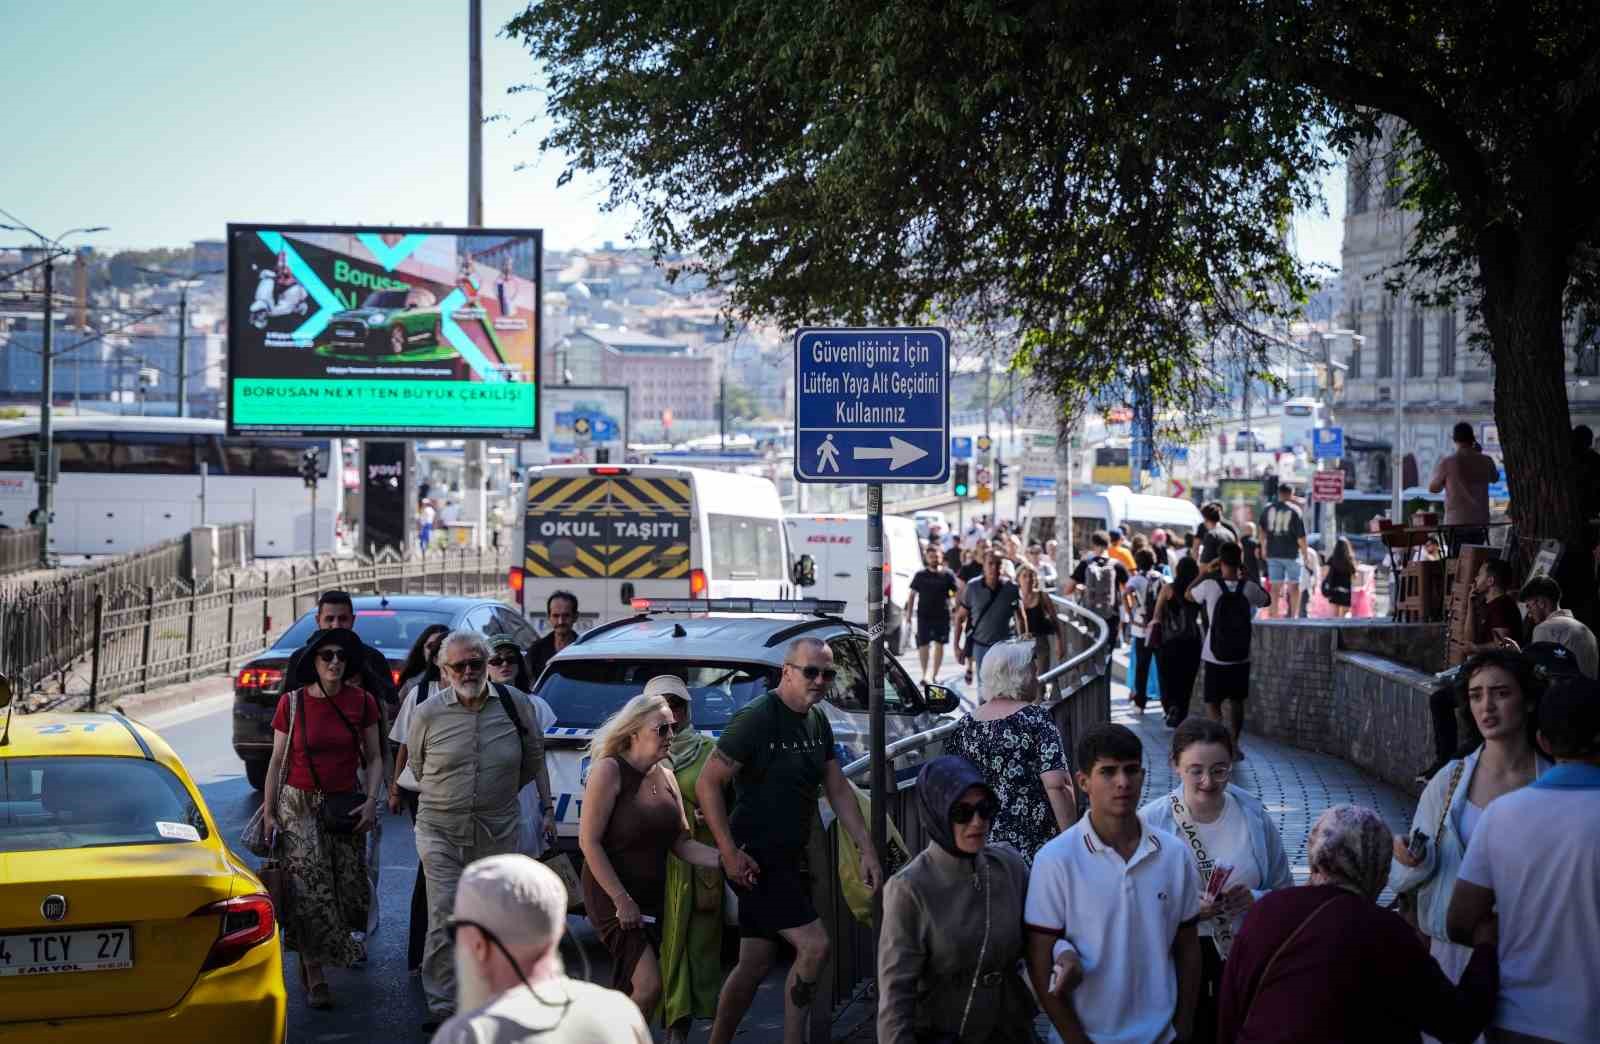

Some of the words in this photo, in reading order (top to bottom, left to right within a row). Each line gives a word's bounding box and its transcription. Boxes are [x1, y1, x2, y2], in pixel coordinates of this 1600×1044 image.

[812, 340, 900, 368] Güvenliğiniz
[904, 335, 930, 368] İçin
[242, 386, 319, 398] BORUSAN
[803, 372, 839, 394] Lütfen
[842, 372, 869, 400] Yaya
[872, 371, 889, 394] Alt
[891, 371, 940, 400] Geçidini
[836, 402, 906, 424] Kullanınız
[540, 522, 601, 537] OKUL
[613, 522, 679, 540] TAŞITI
[29, 935, 72, 962] TCY
[96, 932, 125, 959] 27
